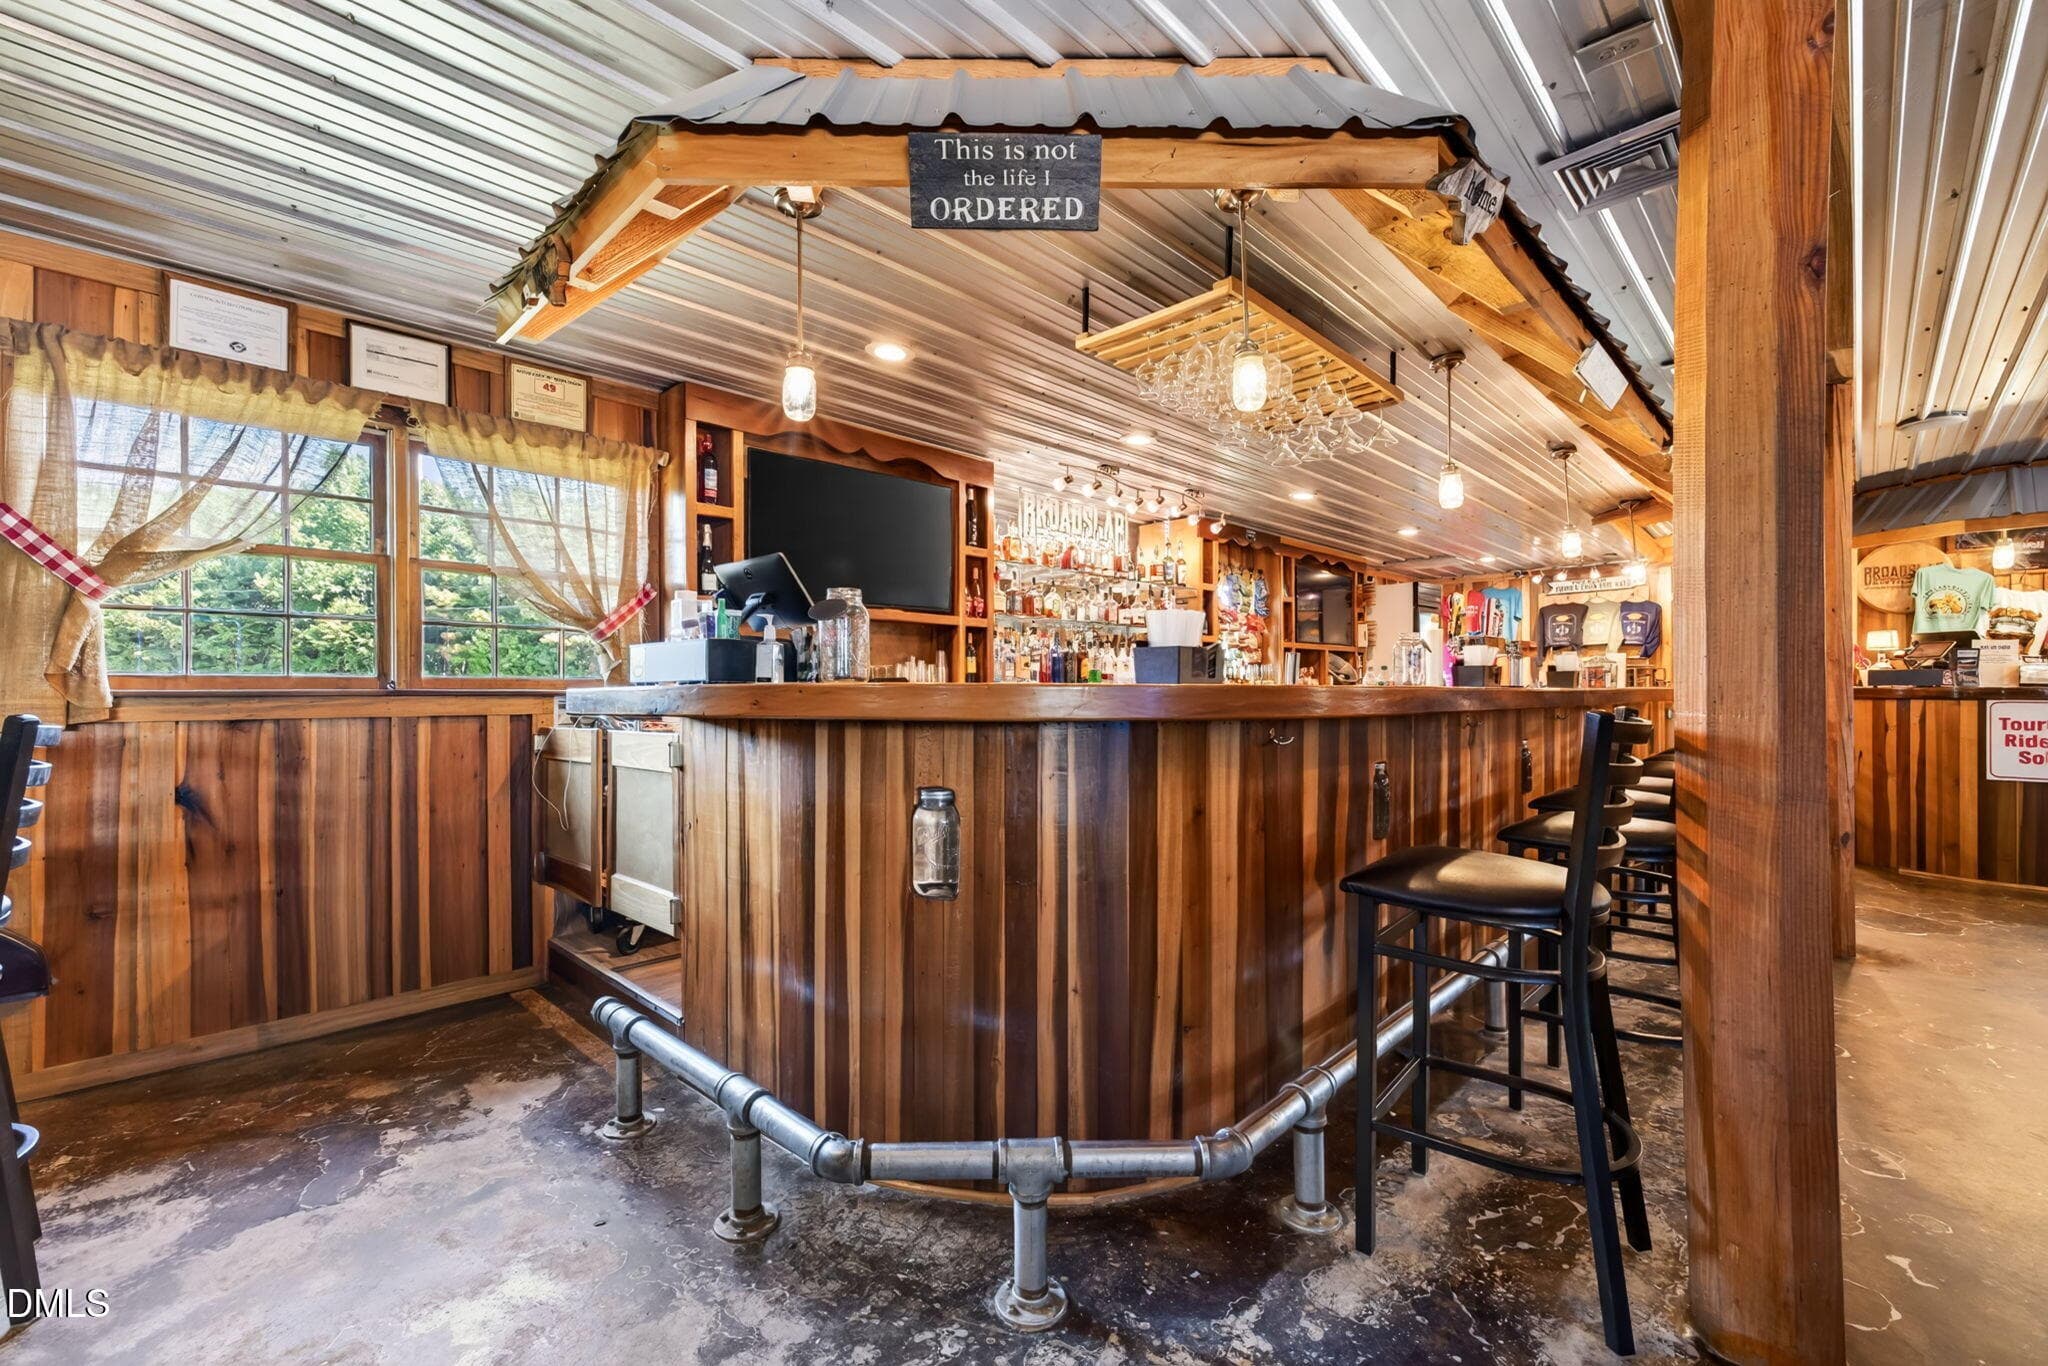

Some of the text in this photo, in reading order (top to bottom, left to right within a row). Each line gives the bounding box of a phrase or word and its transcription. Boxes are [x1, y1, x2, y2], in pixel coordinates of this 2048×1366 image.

[934, 138, 1078, 160] This is not
[964, 169, 995, 186] the
[1003, 169, 1036, 186] life
[929, 197, 1083, 223] ORDERED
[543, 383, 556, 392] 49
[1998, 717, 2048, 731] Tour
